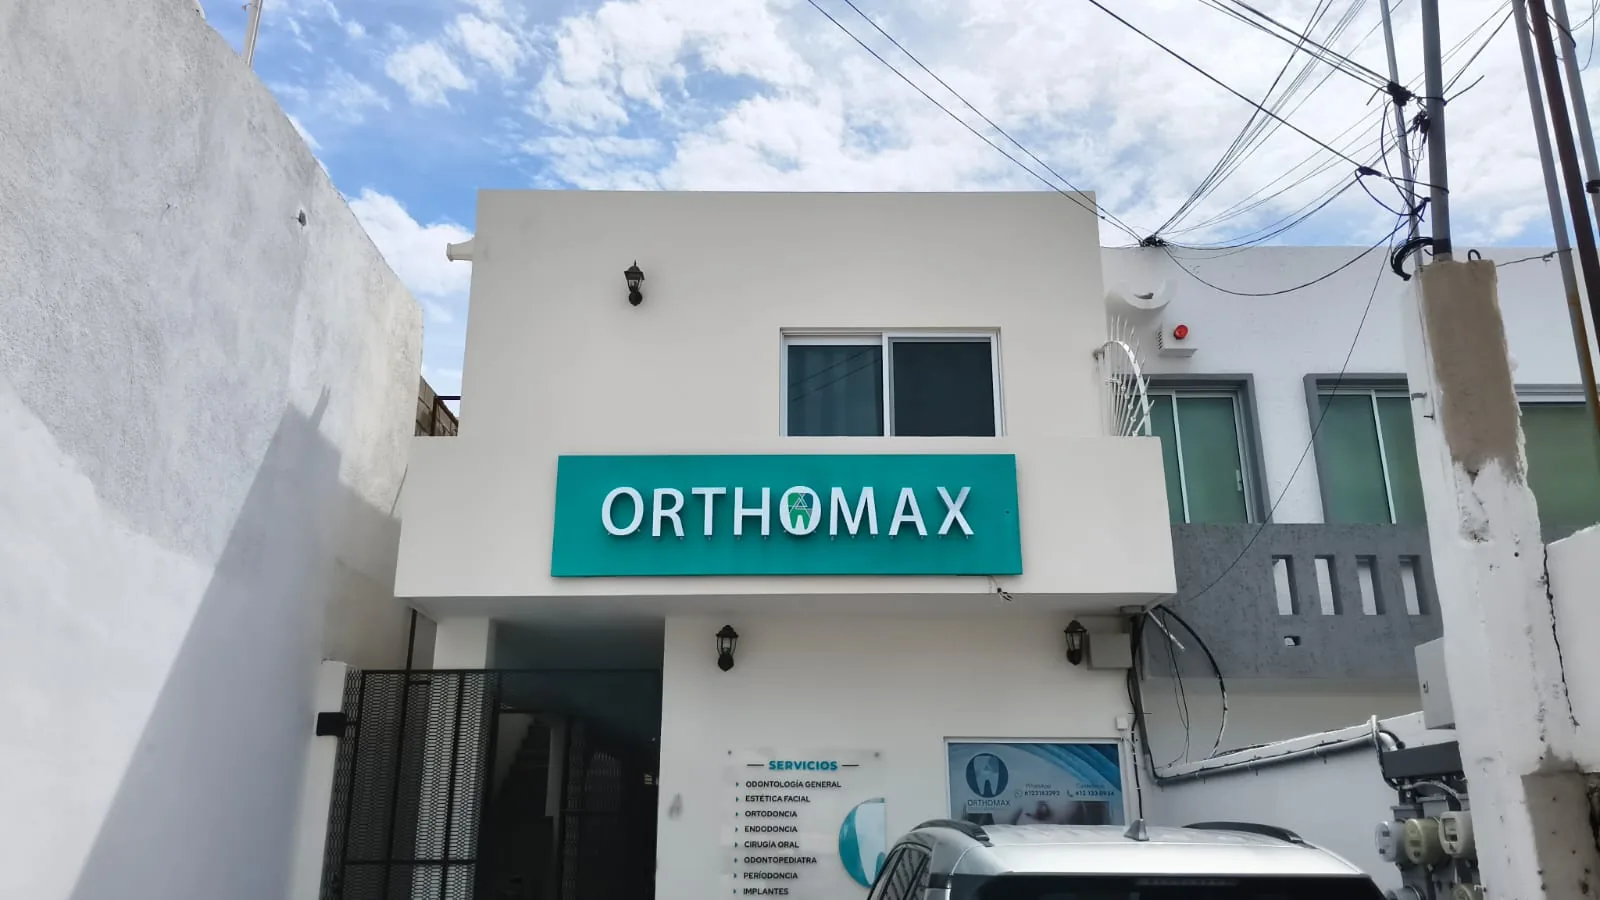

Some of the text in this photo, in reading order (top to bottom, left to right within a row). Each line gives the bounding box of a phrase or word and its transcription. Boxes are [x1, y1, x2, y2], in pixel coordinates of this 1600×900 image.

[601, 485, 975, 537] ORTHOMAX
[768, 760, 838, 771] SERVICIOS
[745, 779, 804, 788] ODONTOLOGÍA
[967, 799, 1011, 807] ORTHOMAX
[744, 810, 798, 818] ORTODONCIA
[744, 825, 798, 833] ENDODONCIA
[744, 840, 800, 849] CIRUGÍA ORAL
[743, 856, 818, 864] ODONTOPEDIATRA
[743, 871, 799, 880] PERÍODONCIA
[743, 887, 789, 895] IMPLANTES
